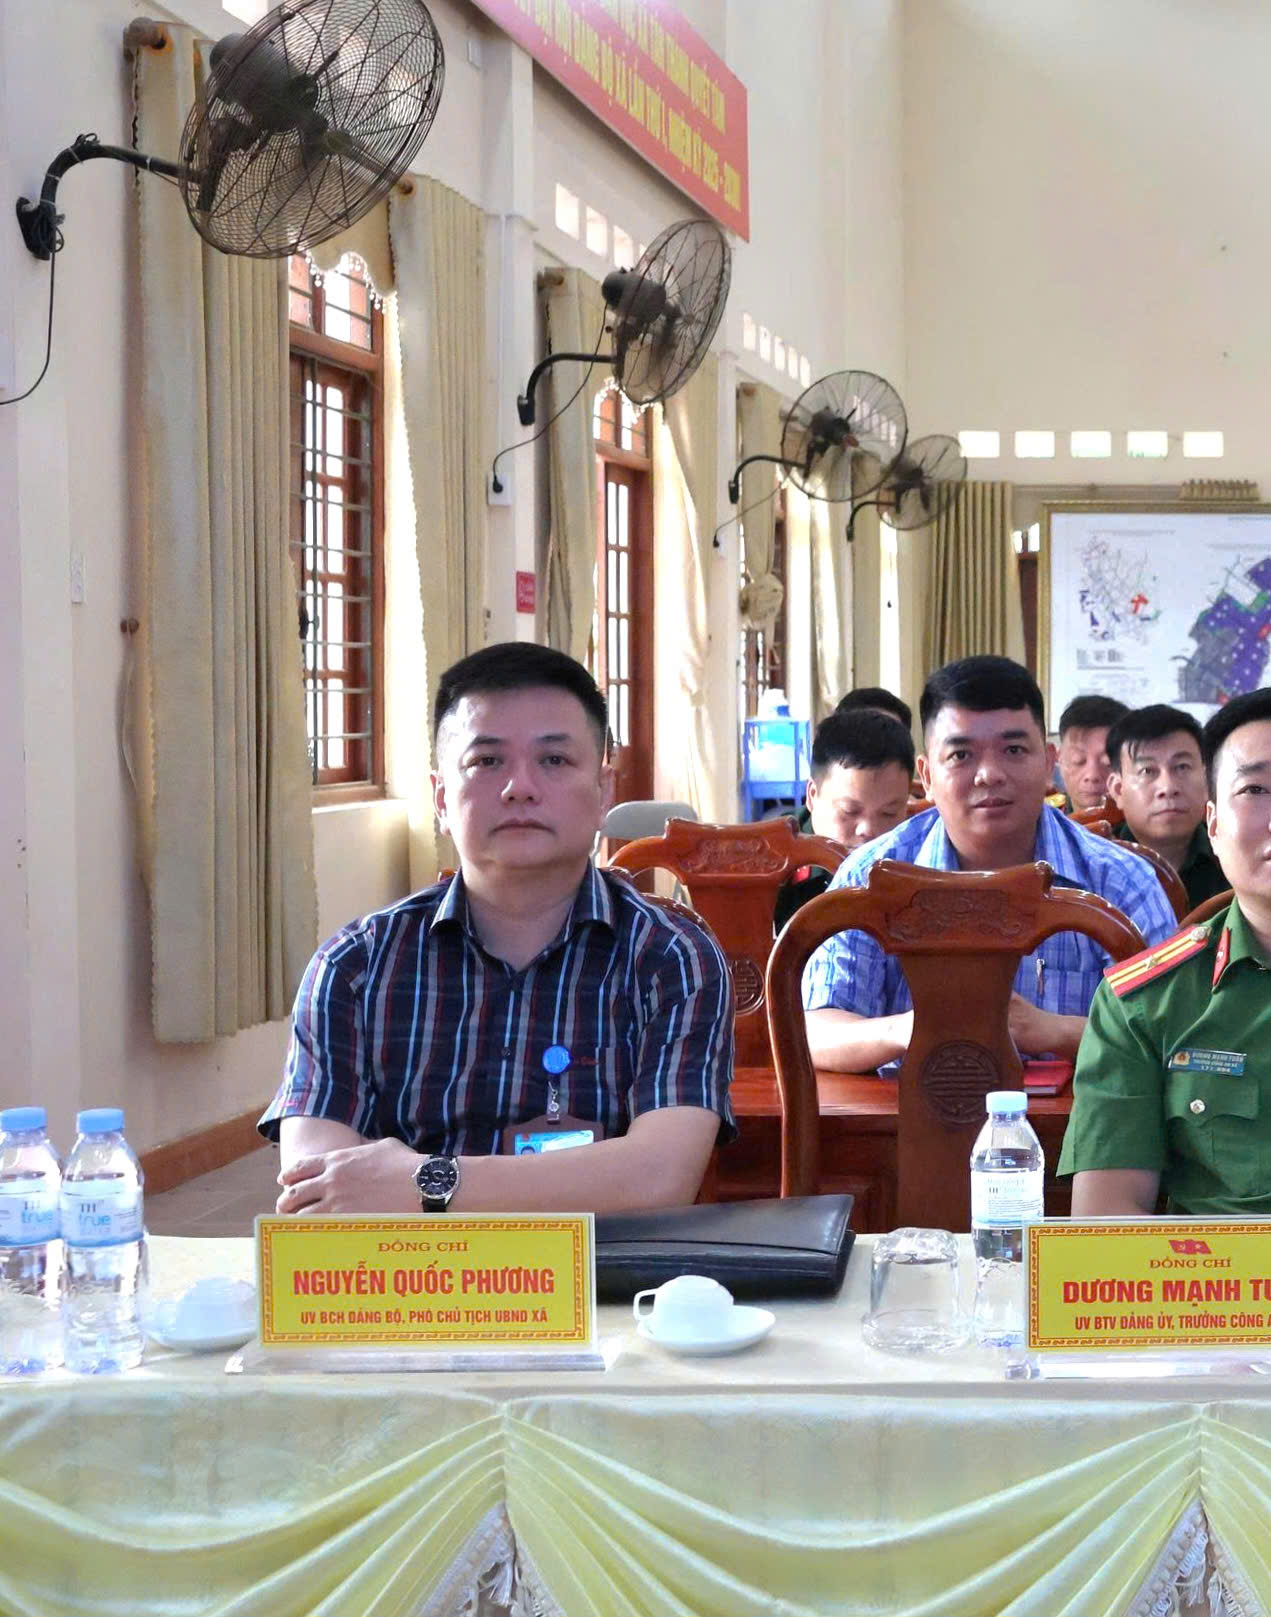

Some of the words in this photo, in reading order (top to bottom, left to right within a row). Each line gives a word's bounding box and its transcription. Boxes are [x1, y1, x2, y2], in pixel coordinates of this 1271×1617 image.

[1202, 1256, 1232, 1269] CHÍ
[293, 1259, 386, 1296] NGUYỄN
[393, 1260, 455, 1298] QUỐC
[461, 1265, 555, 1295] PHƯƠNG
[1063, 1278, 1154, 1304] DƯƠNG
[1162, 1278, 1242, 1307] MẠNH
[300, 1310, 316, 1325] UV
[320, 1310, 346, 1324] BCH
[408, 1306, 434, 1324] PHÓ
[437, 1305, 461, 1323] CHỦ
[464, 1309, 491, 1326] TỊCH
[494, 1309, 528, 1323] UBND
[1075, 1315, 1091, 1330] UV
[1094, 1315, 1117, 1330] BTV
[1120, 1311, 1154, 1330] ĐẢNG
[1177, 1310, 1227, 1329] TRƯỞNG
[1230, 1311, 1264, 1328] CÔNG
